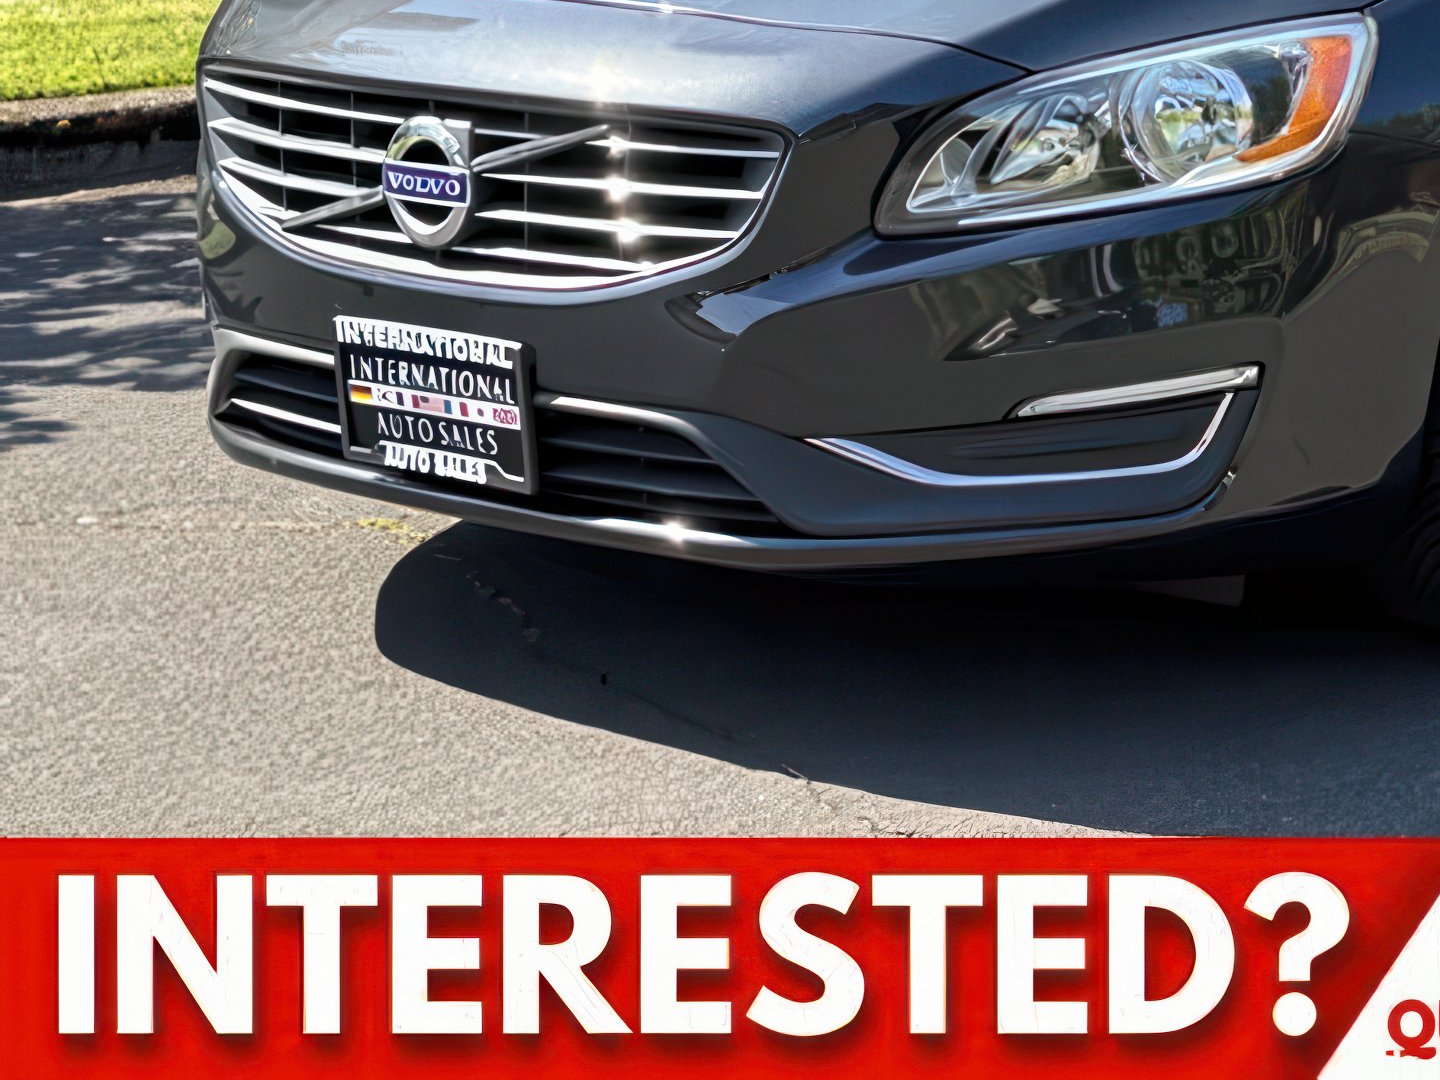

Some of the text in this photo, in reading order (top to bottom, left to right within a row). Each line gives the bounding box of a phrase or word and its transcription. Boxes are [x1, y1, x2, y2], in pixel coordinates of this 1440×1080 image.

[387, 171, 461, 196] VOLVO
[350, 353, 515, 405] INTERNATIONAL
[377, 411, 498, 456] AUTO SALES
